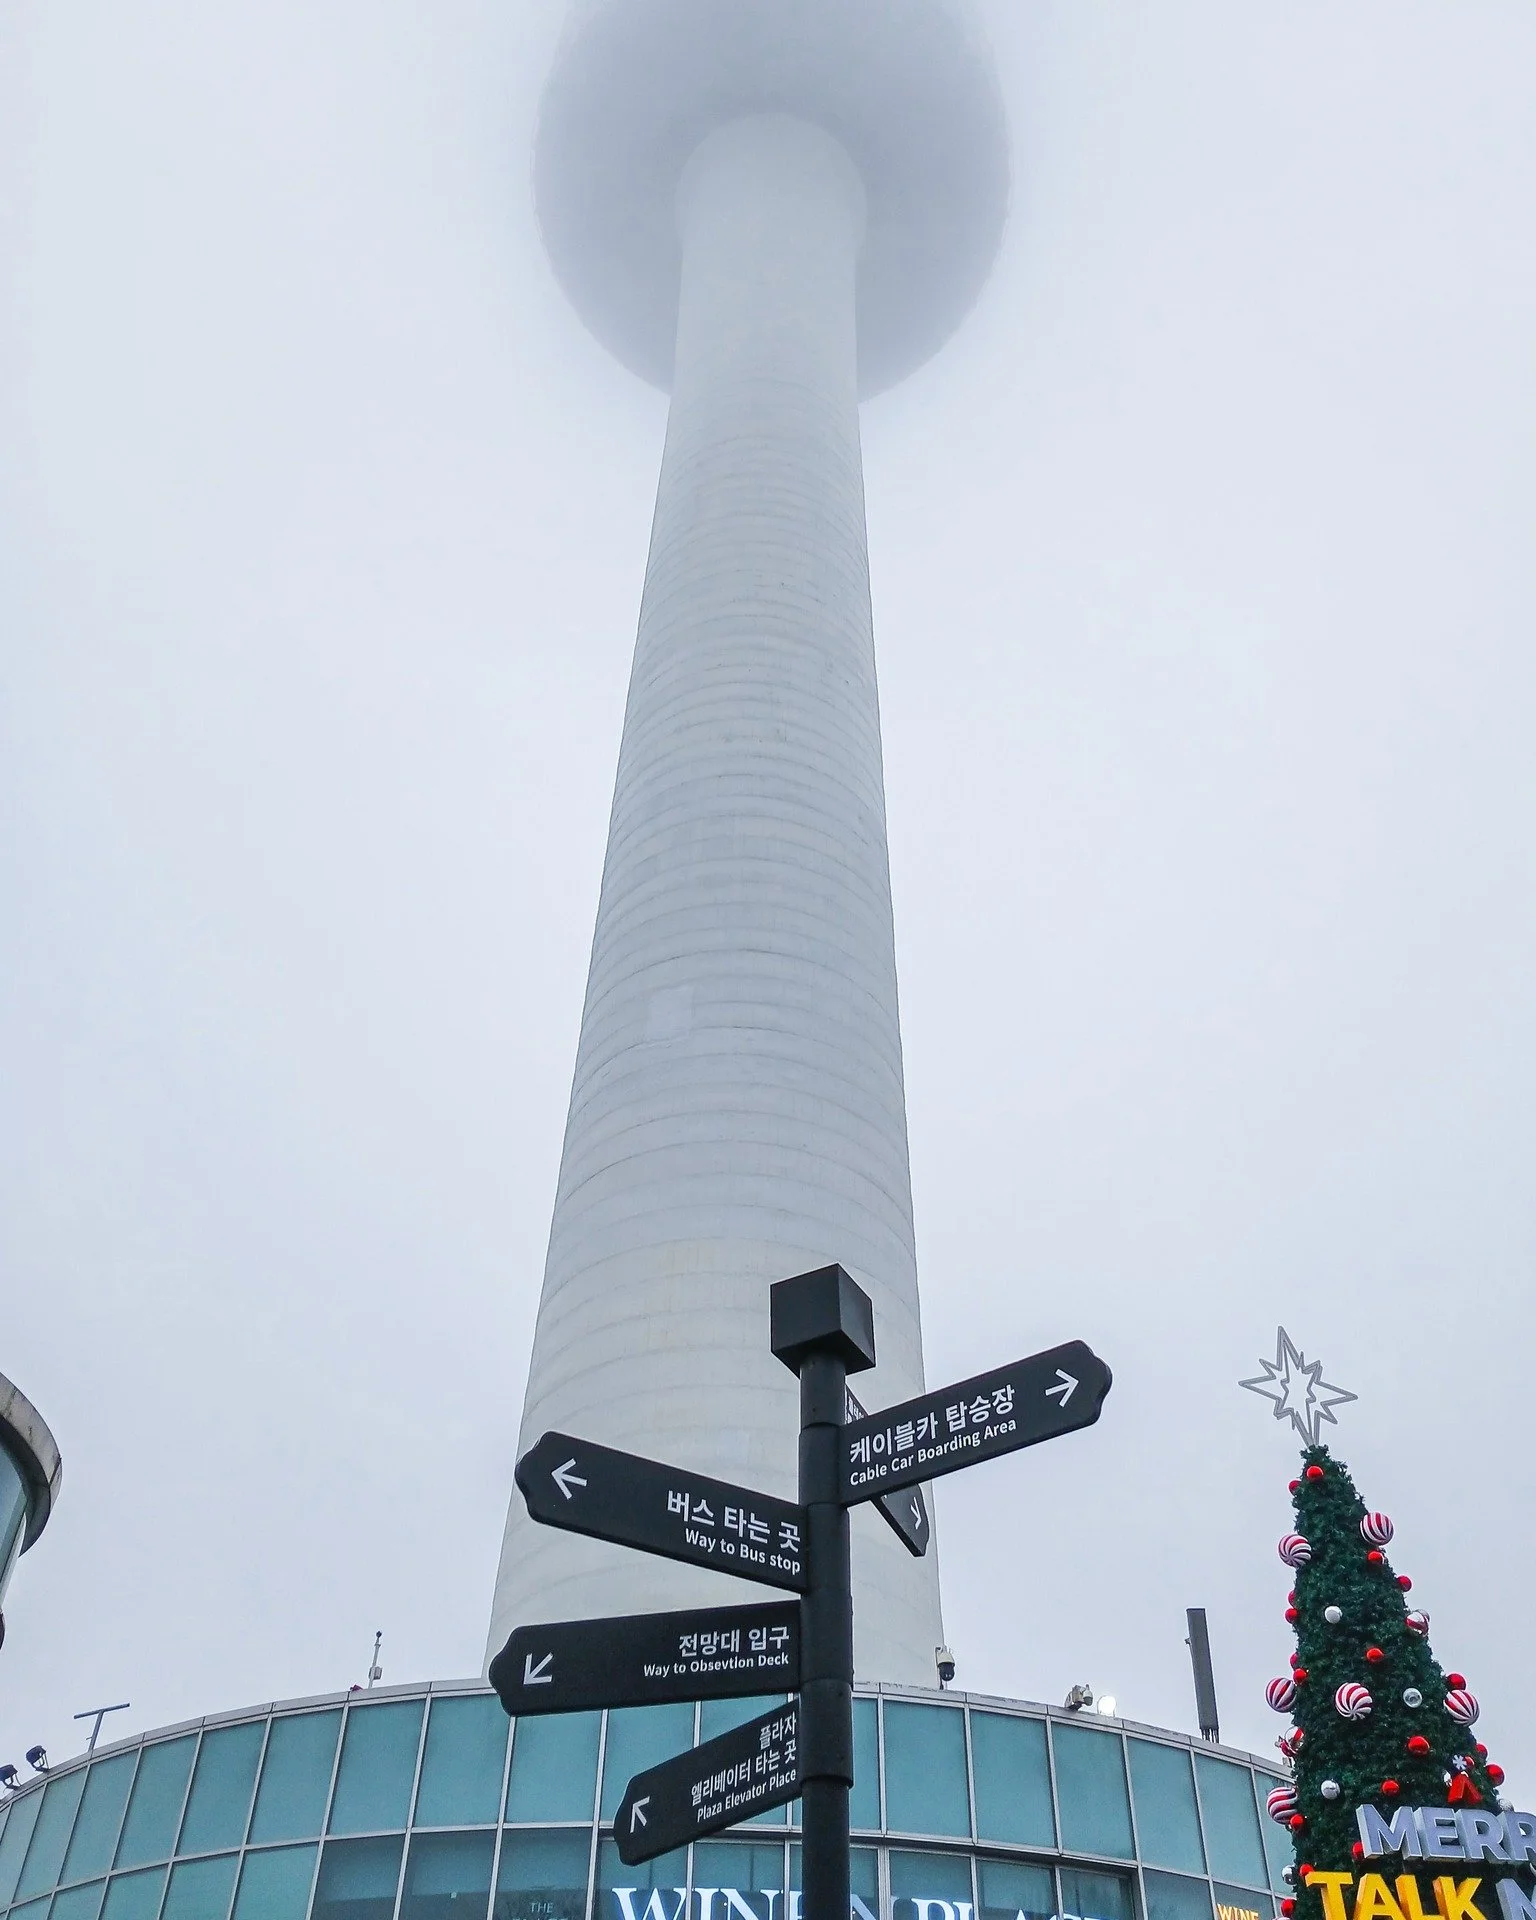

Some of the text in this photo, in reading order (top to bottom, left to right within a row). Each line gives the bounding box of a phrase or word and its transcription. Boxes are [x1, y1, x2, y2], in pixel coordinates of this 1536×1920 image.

[850, 1384, 1015, 1463] 케이블카 탑승장
[850, 1419, 1017, 1486] Cable Car Boarding Area
[667, 1490, 800, 1553] 버스 타는 곳
[685, 1528, 800, 1575] Way to Bus stop
[643, 1664, 670, 1678] Way
[673, 1663, 686, 1674] to
[758, 1652, 789, 1667] Deck
[679, 1626, 790, 1657] 전망대 입구
[759, 1711, 797, 1750] 플라자
[691, 1737, 797, 1806] 엘리베이터 타는 곳
[697, 1769, 797, 1822] Plaza Elevator Place
[530, 1902, 554, 1913] THE
[611, 1887, 803, 1920] WIN
[1305, 1870, 1488, 1920] TALK
